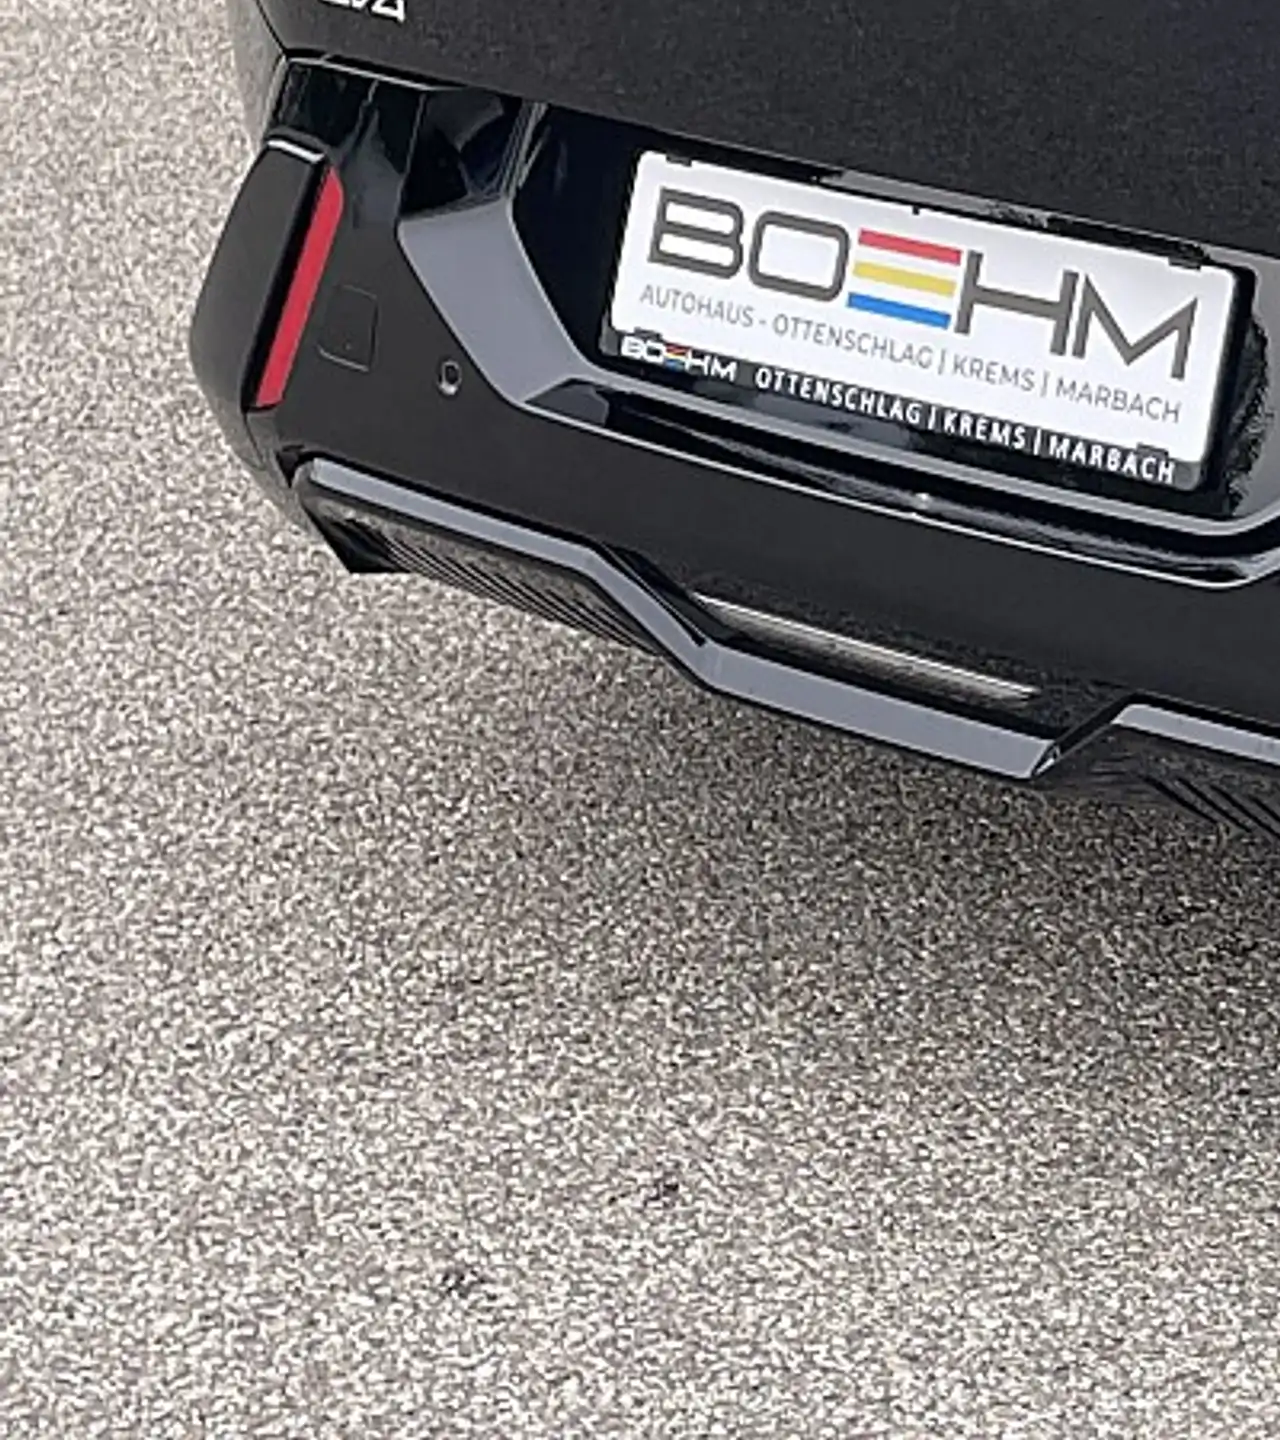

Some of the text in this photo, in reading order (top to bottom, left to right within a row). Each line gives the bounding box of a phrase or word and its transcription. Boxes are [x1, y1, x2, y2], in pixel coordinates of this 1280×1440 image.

[640, 284, 754, 328] AUTOHAUS
[772, 313, 934, 370] OTTENSCHLAG
[952, 355, 1036, 392] KREMS
[1056, 376, 1182, 424] MARBACH
[647, 187, 1199, 381] BOEHM
[621, 336, 737, 382] BOEHM
[755, 367, 921, 425] OTTENSCHLAG
[943, 412, 1026, 450] KREMS
[1050, 435, 1176, 485] MARBACH
